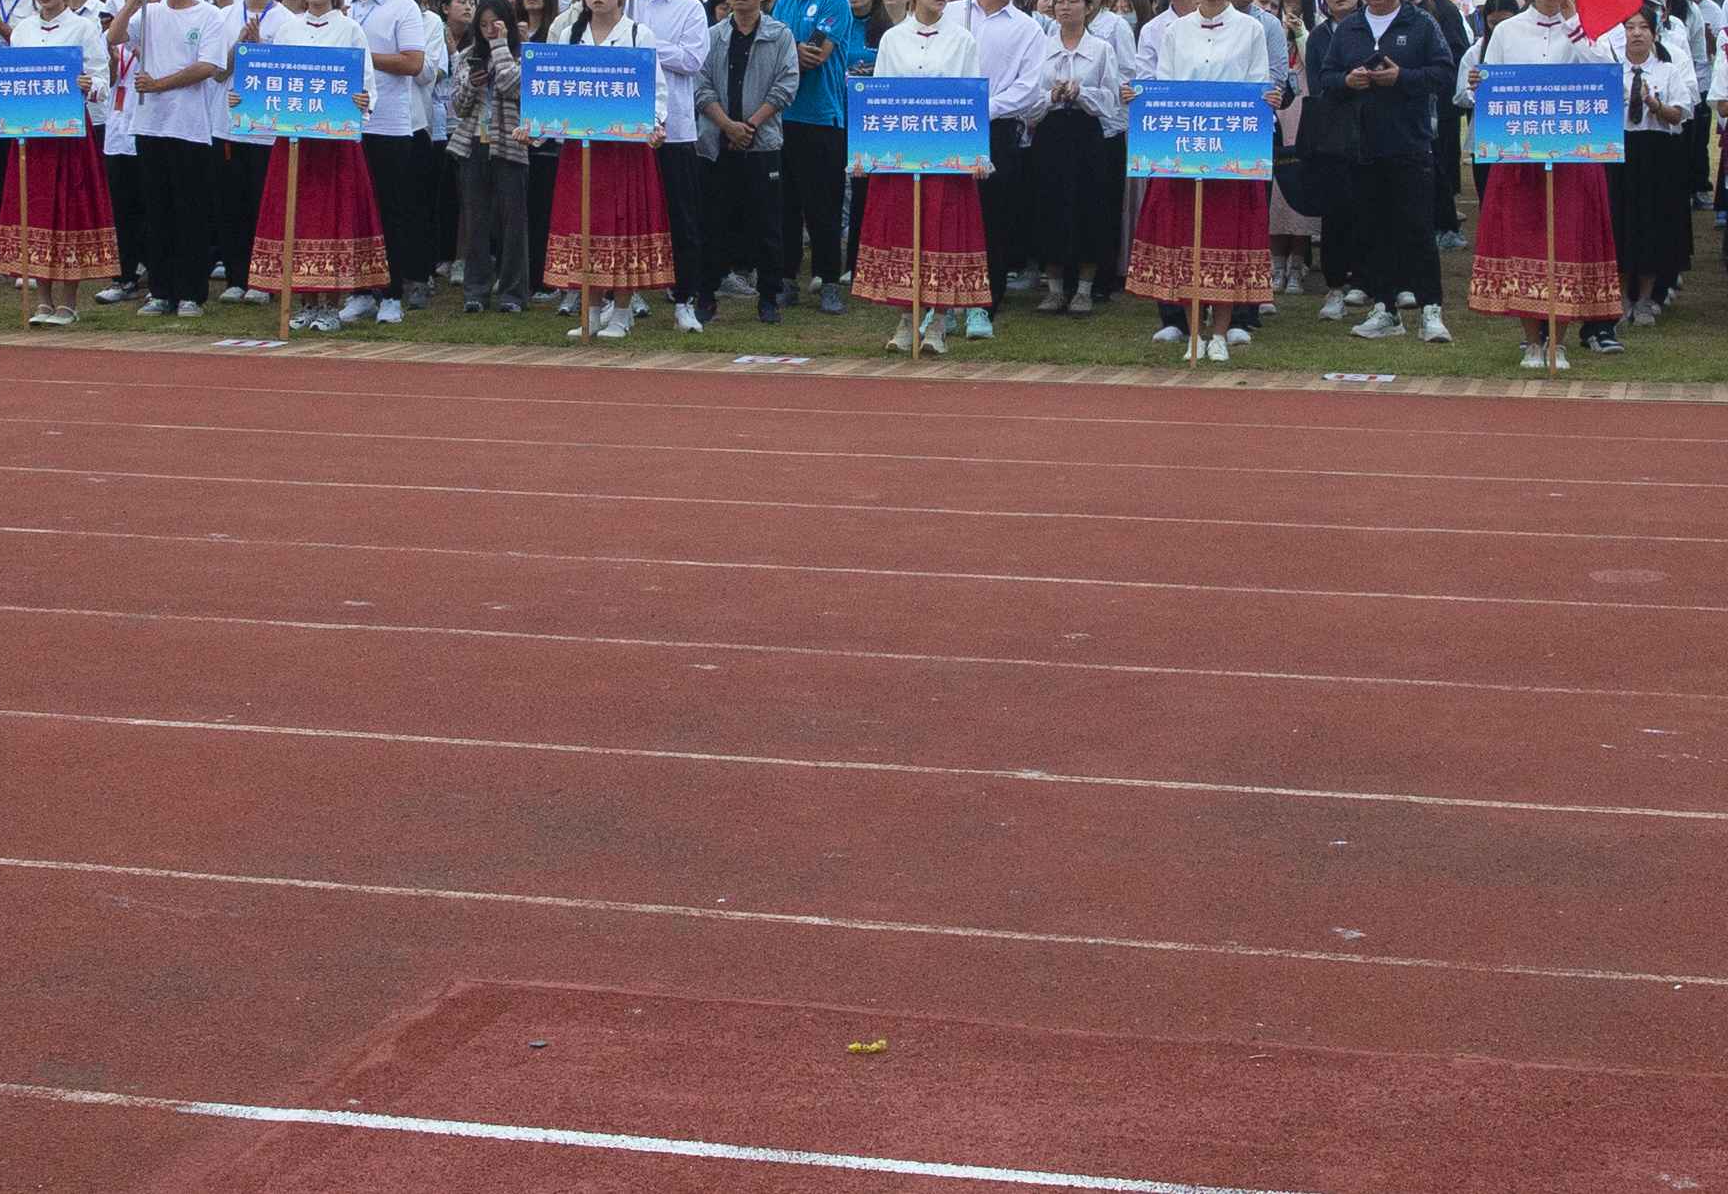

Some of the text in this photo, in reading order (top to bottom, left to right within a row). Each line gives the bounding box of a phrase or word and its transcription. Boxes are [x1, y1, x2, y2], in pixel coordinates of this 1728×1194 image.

[243, 76, 349, 96] 外国语学院
[530, 79, 641, 99] 教育学院代表队
[264, 96, 326, 114] 代表队
[1487, 99, 1609, 117] 新闻传播与影视
[862, 114, 979, 133] 法学院代表队
[1141, 114, 1259, 133] 化学与化工学院
[1505, 118, 1593, 137] 学院代表队
[1174, 135, 1224, 154] 代表队
